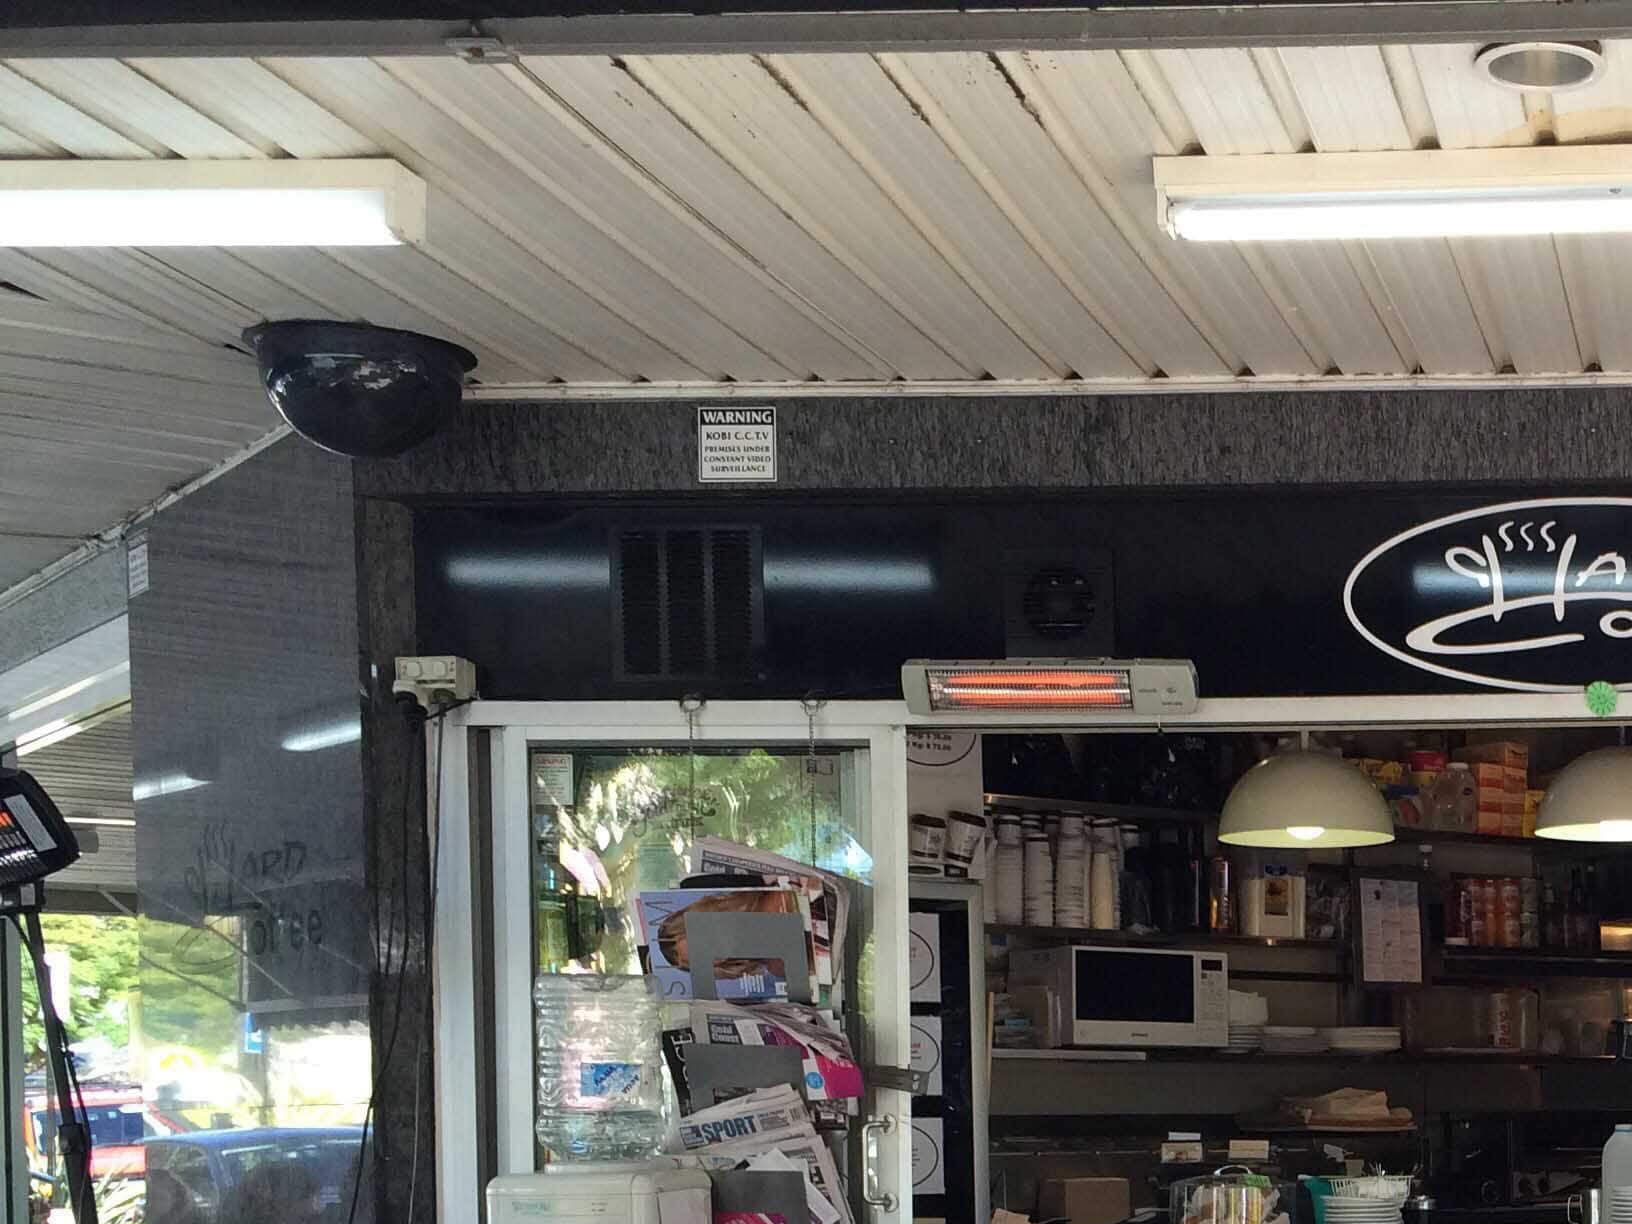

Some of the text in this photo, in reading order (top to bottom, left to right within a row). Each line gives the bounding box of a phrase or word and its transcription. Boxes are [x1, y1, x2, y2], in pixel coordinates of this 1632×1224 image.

[702, 411, 772, 424] WARNING
[706, 431, 731, 441] KOBI
[701, 1115, 757, 1141] SPORT
